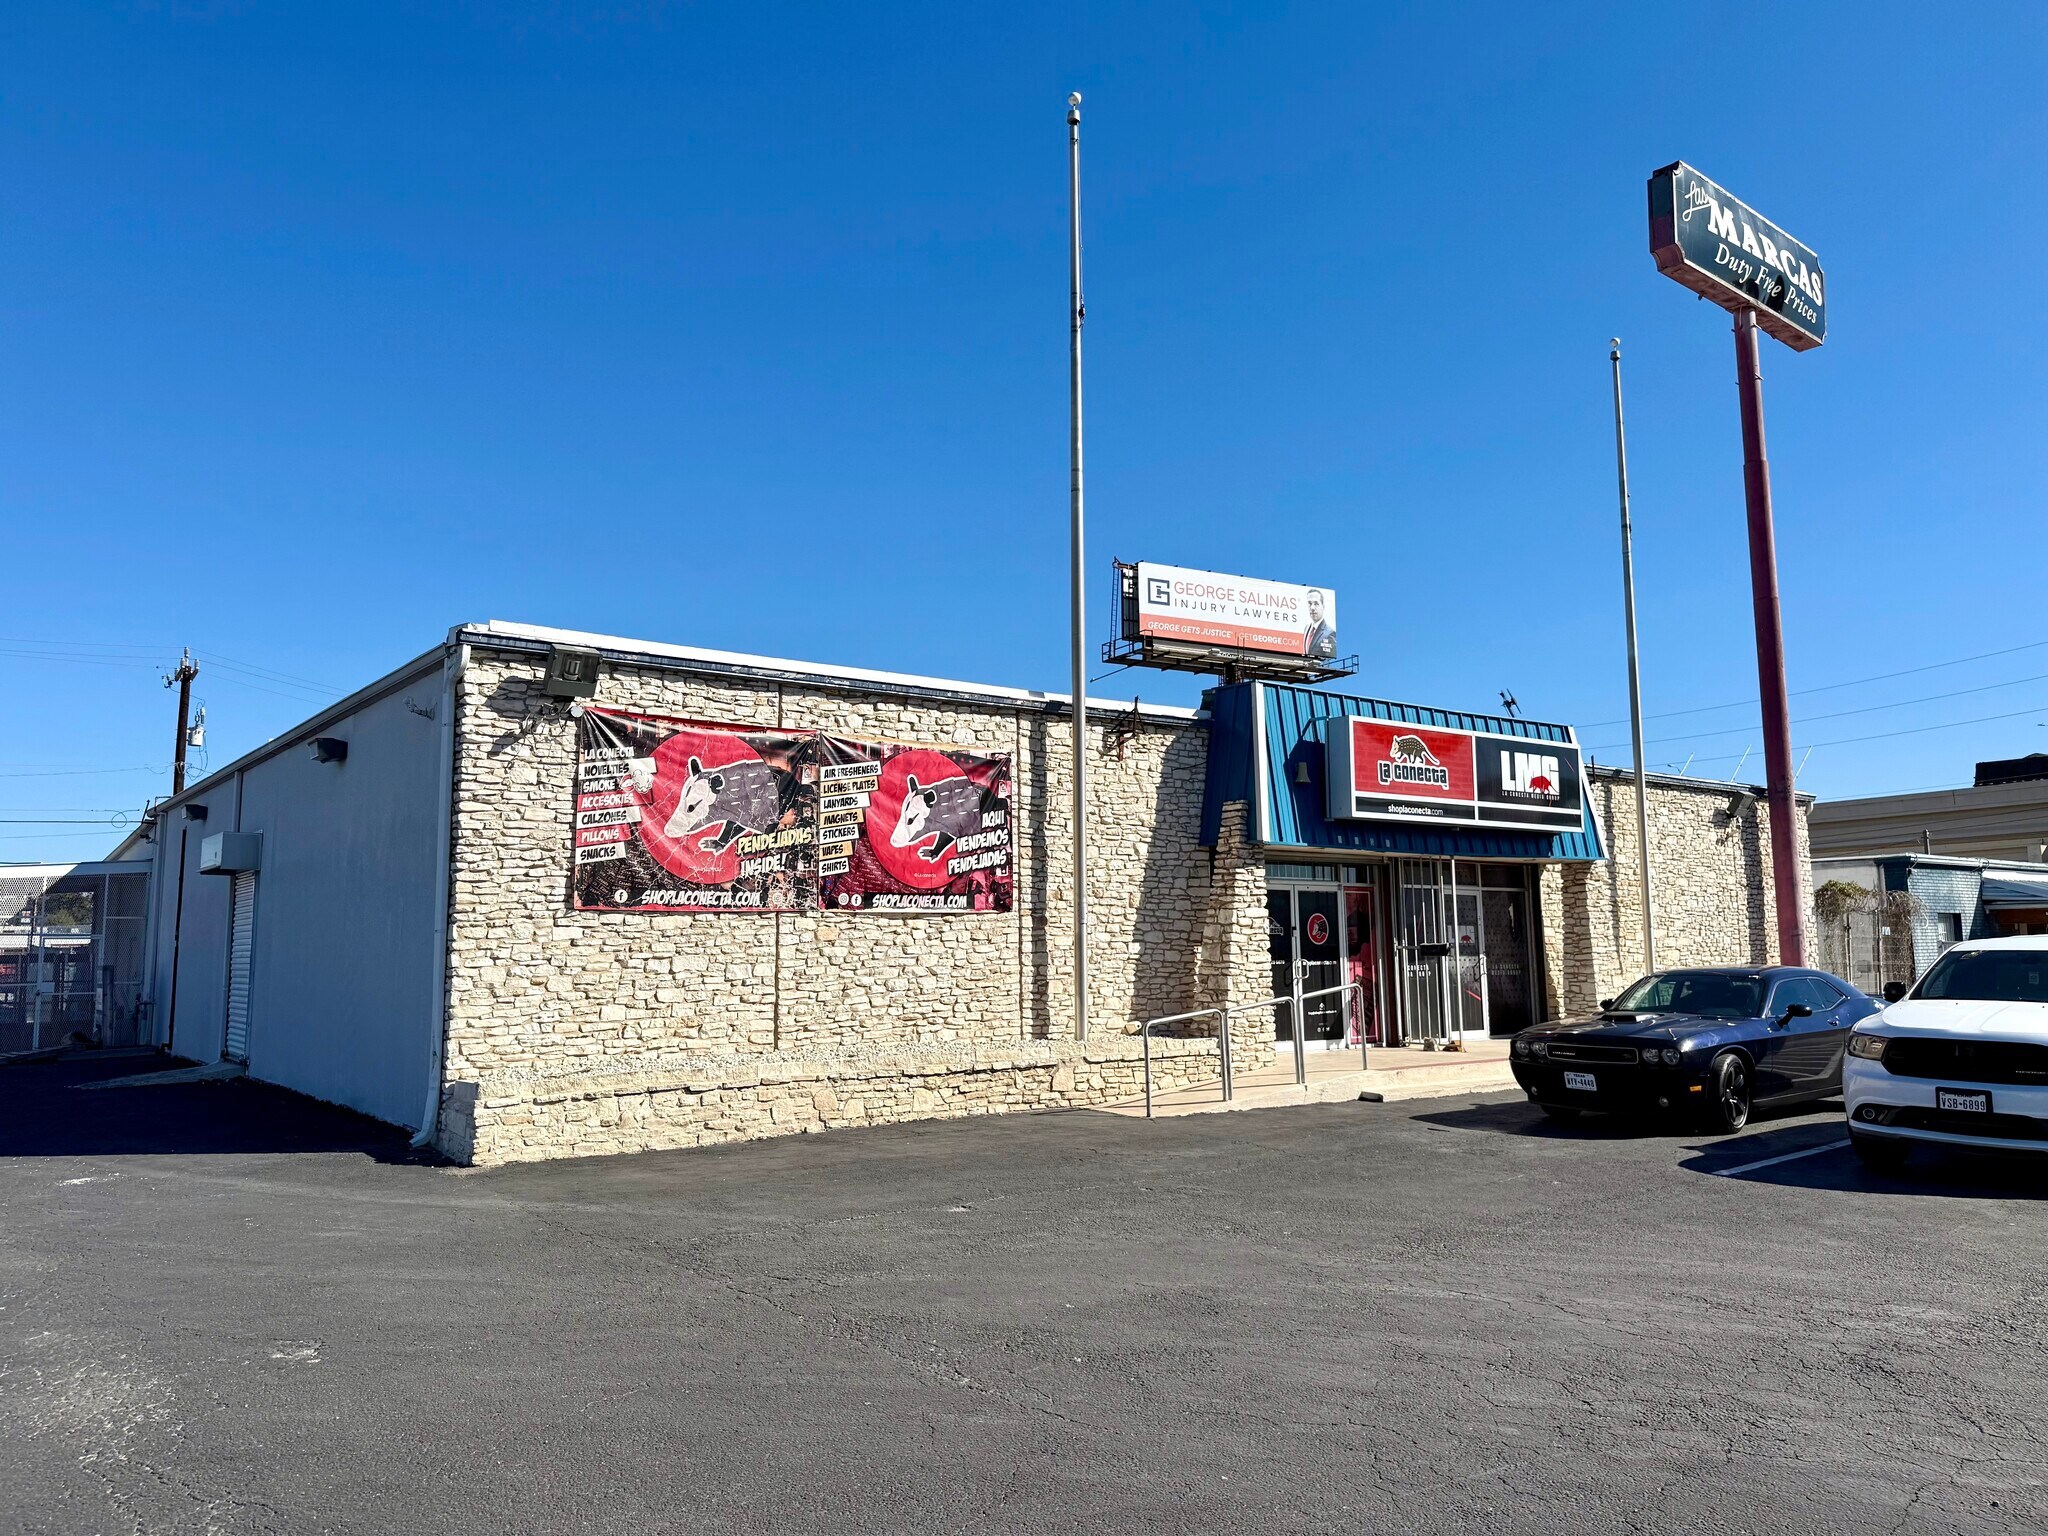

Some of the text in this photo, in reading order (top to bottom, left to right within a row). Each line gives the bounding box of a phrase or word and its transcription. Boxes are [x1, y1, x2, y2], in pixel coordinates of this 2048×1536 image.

[1682, 180, 1712, 222] Las
[1707, 197, 1822, 307] MARCAS
[1714, 242, 1817, 324] Duty Free Prices
[1174, 581, 1297, 610] GEORGE SALINAS
[1174, 598, 1297, 623] INJURY LAWYERS
[1147, 621, 1299, 647] GEORGE GETS JUSTICE GETGEORGE.COM
[584, 746, 635, 760] LA CONECTA
[584, 762, 630, 777] NOVELTIES
[823, 764, 879, 779] AIR FRESHENERS
[1500, 750, 1560, 796] LMG
[583, 780, 616, 793] SMOKE
[823, 779, 876, 794] LICENSE PLATES
[581, 793, 634, 809] ACCESORIES
[823, 796, 858, 809] LANYARDS
[1388, 804, 1443, 815] shoplaconecta.com
[581, 810, 627, 825] CALZONES
[823, 811, 858, 826] MAGNETS
[981, 810, 1005, 829] AQUI
[581, 828, 620, 843] PILLOWS
[736, 827, 812, 854] PENDEJADAS
[822, 826, 856, 840] STICKERS
[956, 828, 1009, 854] VENDEMOS
[580, 846, 616, 860] SNACKS
[821, 844, 844, 857] VAPES
[740, 854, 787, 877] INSIDE!
[821, 860, 847, 874] SHIRTS
[947, 849, 1007, 876] PENDEJADAS
[641, 889, 762, 907] SHOPLACONECTA.COM
[872, 894, 967, 909] SHOPLACONECTA.COM
